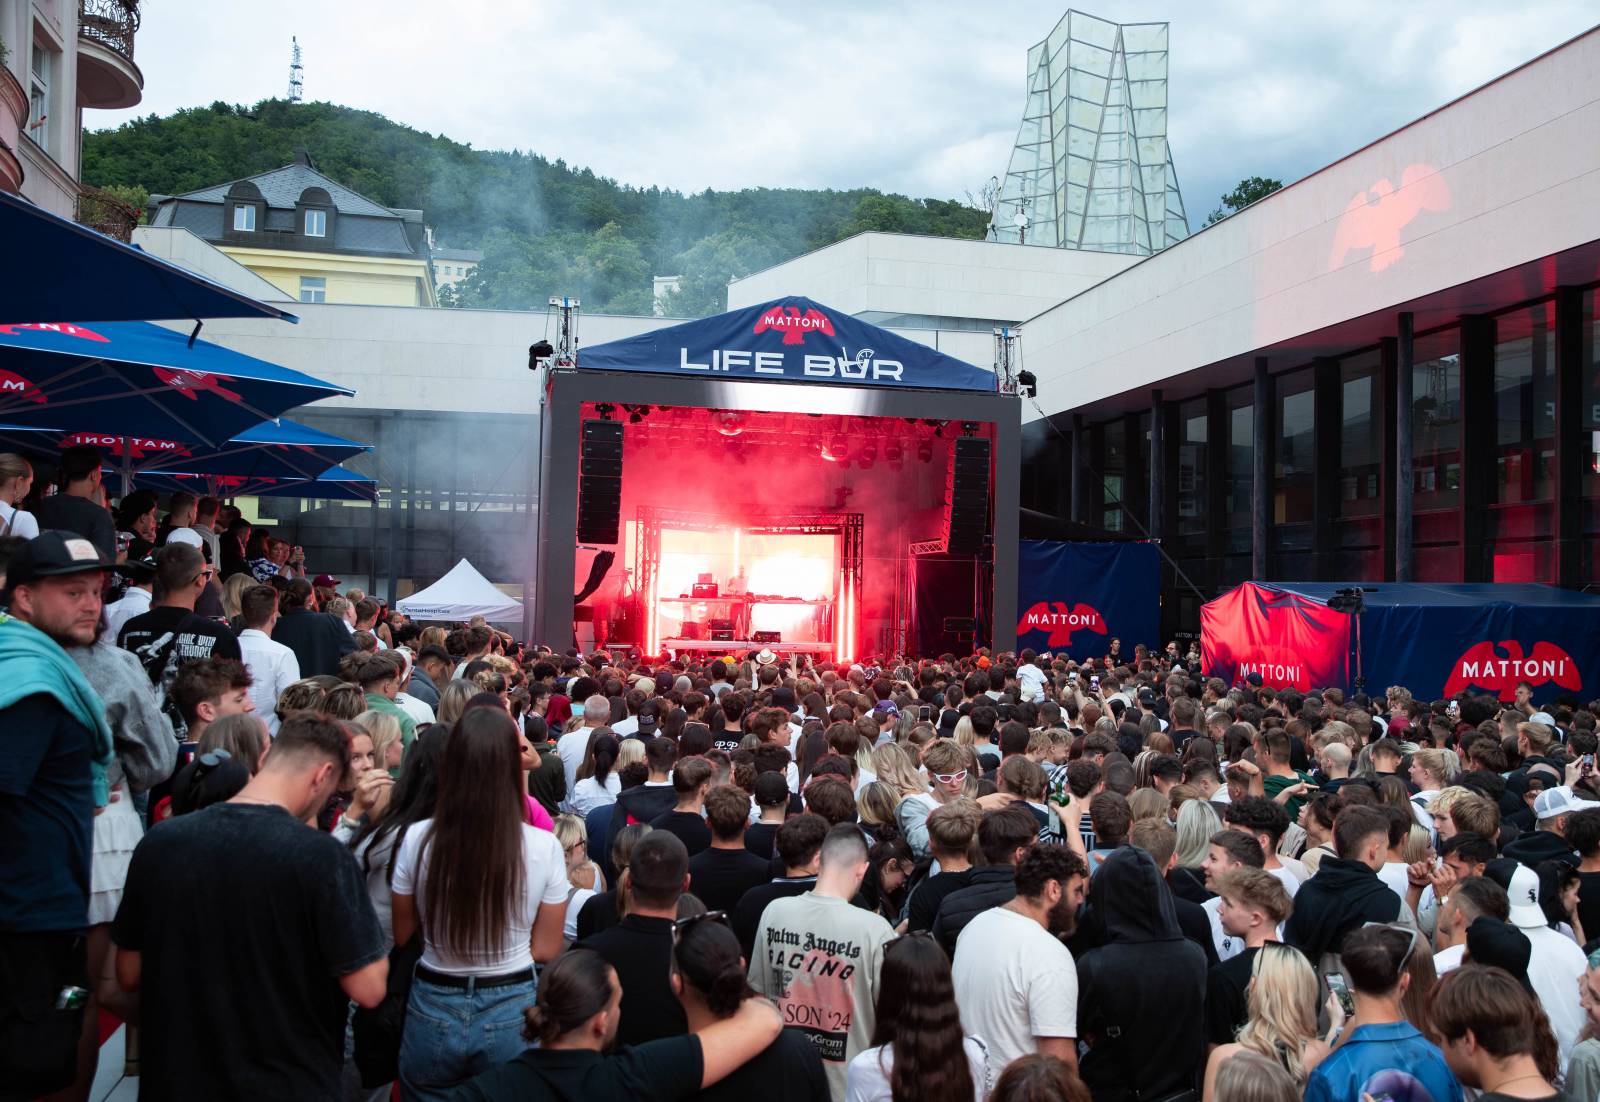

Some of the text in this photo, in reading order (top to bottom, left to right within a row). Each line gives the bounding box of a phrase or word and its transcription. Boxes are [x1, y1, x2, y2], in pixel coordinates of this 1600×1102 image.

[764, 315, 825, 329] MATTONI
[680, 347, 785, 374] LIFE
[1027, 613, 1095, 625] MATTONI
[1240, 662, 1300, 682] MATTONI
[1462, 660, 1564, 678] MATTONI
[766, 927, 861, 959] Palm Angels
